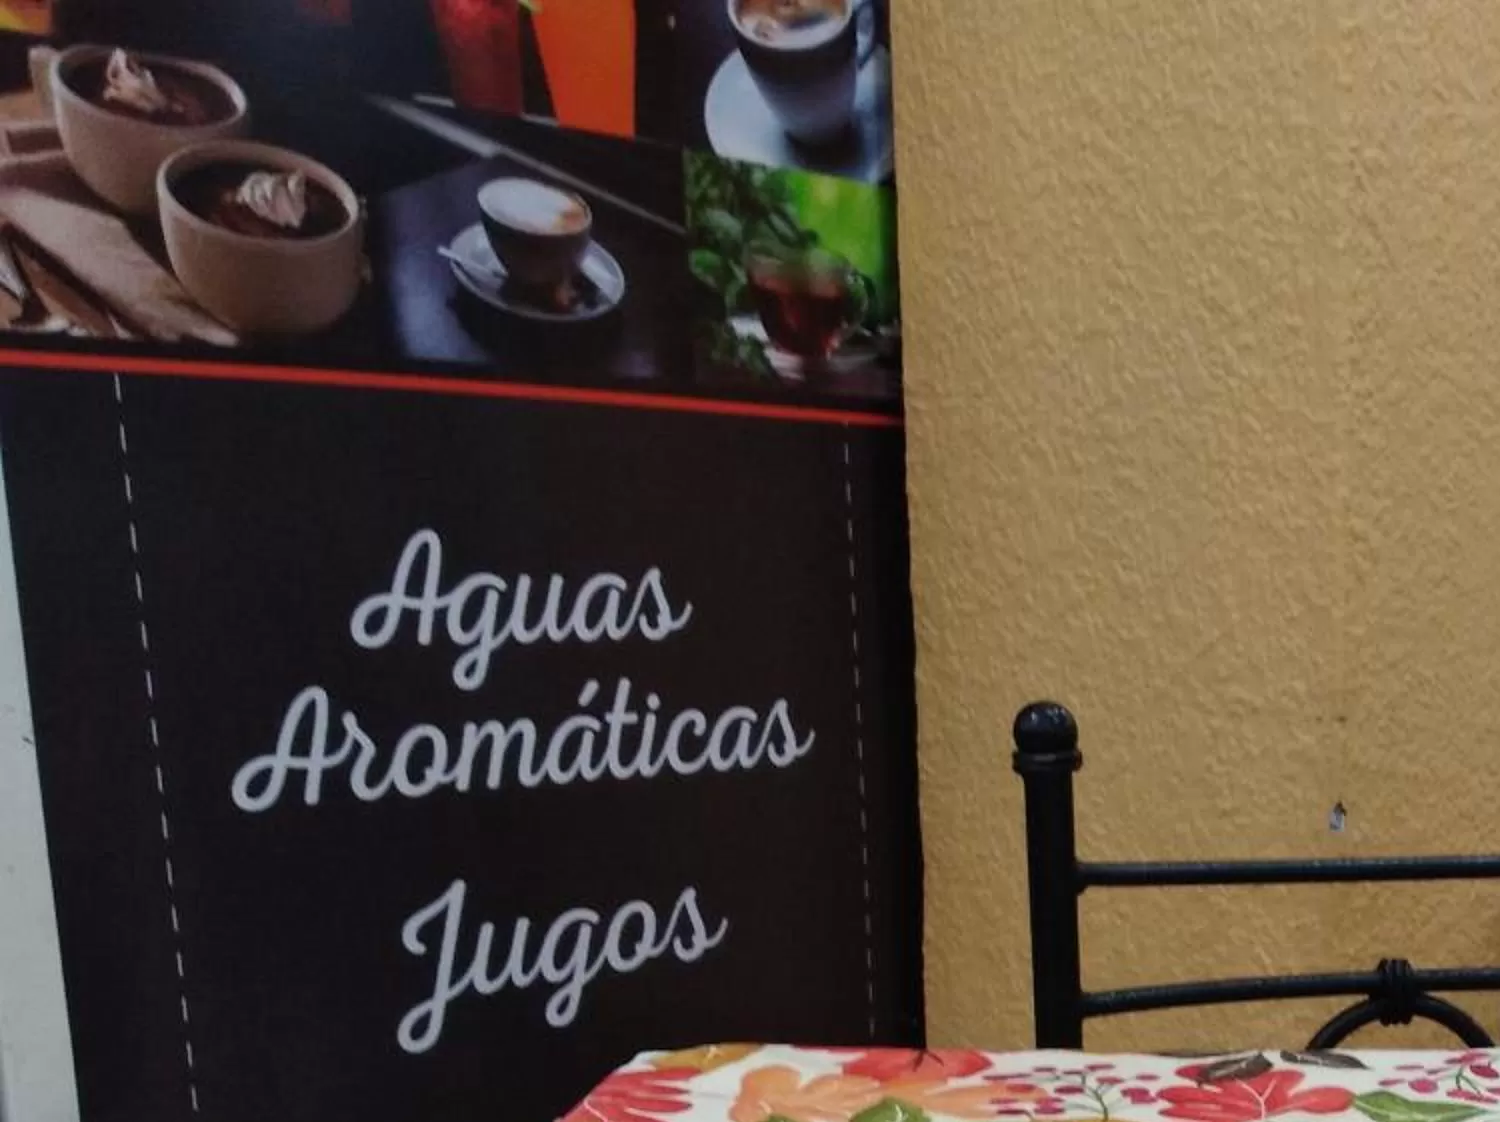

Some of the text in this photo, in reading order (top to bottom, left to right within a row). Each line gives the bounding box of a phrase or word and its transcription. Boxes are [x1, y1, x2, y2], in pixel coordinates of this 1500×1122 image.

[350, 529, 692, 691] Aguas
[231, 677, 815, 812] Aromáticas
[397, 879, 728, 1053] Jugos
